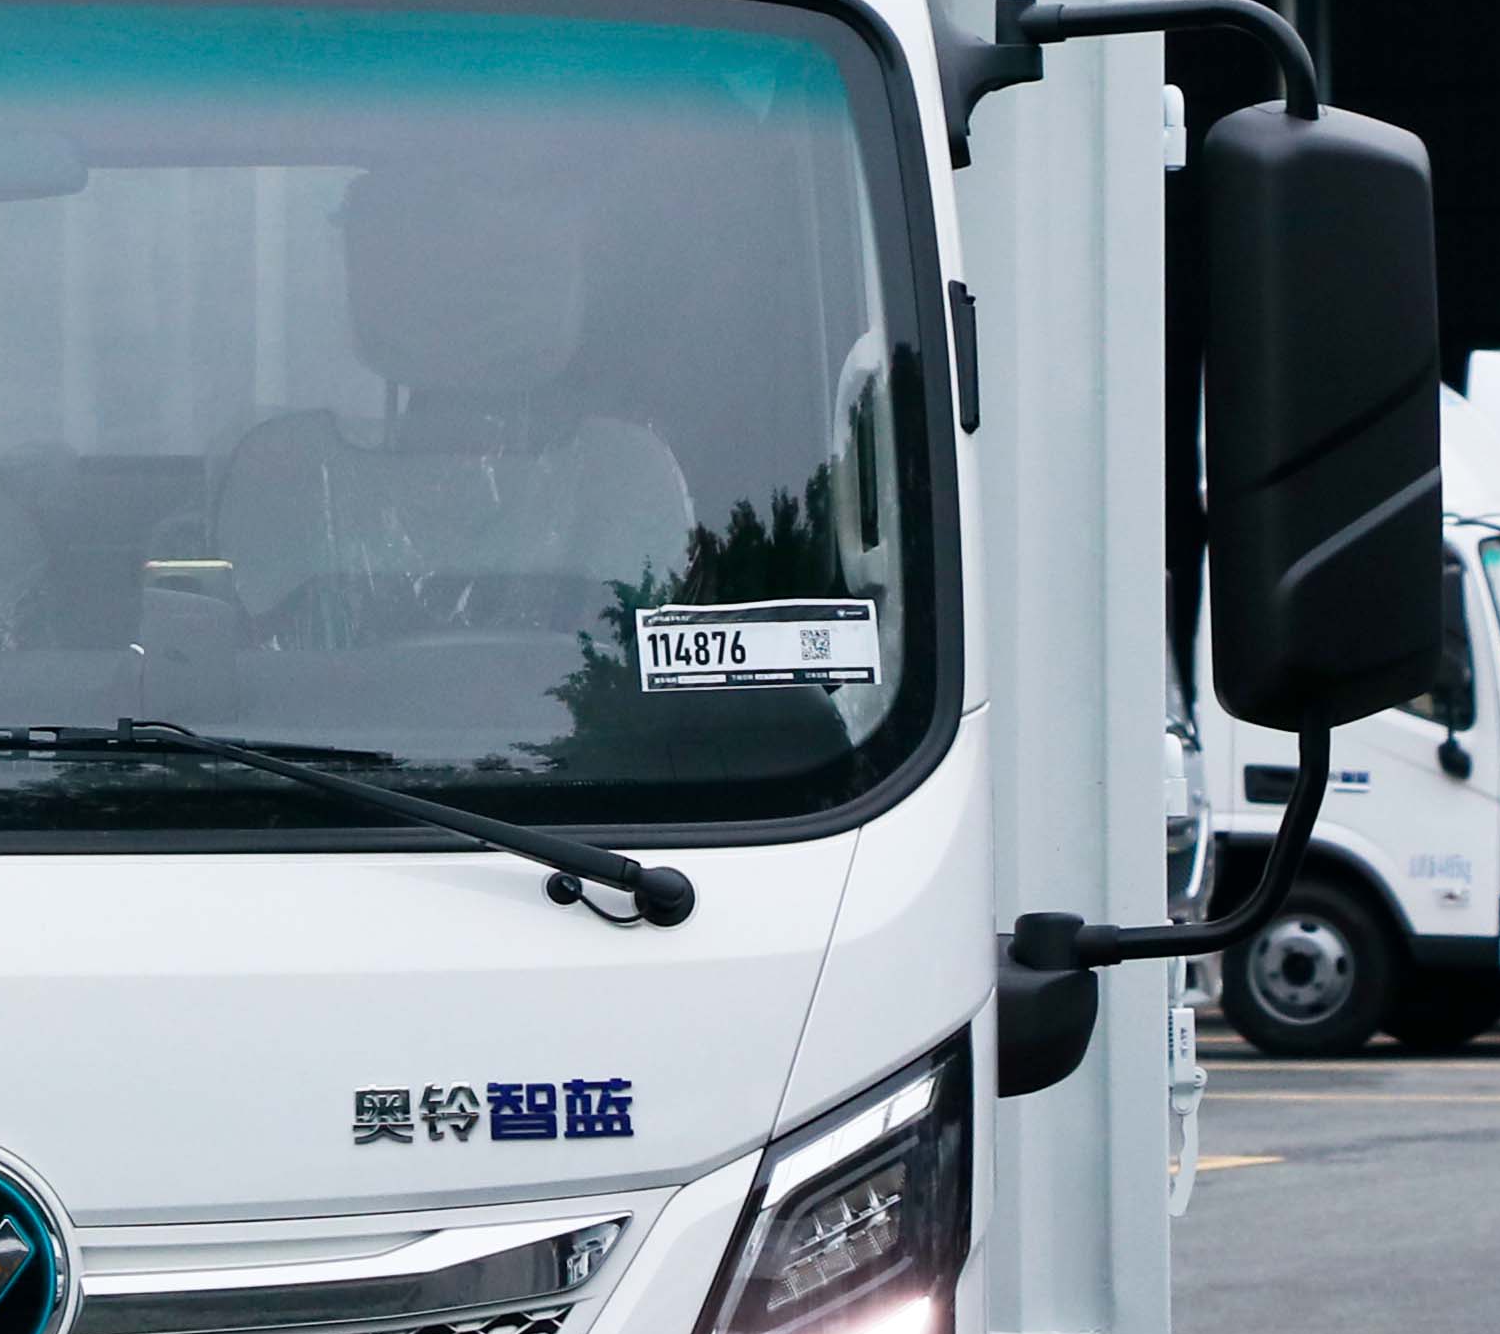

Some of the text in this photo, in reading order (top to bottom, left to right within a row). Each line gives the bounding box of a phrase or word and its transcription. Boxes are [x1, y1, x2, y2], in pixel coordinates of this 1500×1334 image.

[646, 629, 748, 669] 114876
[352, 1077, 635, 1146] 奥铃智蓝
